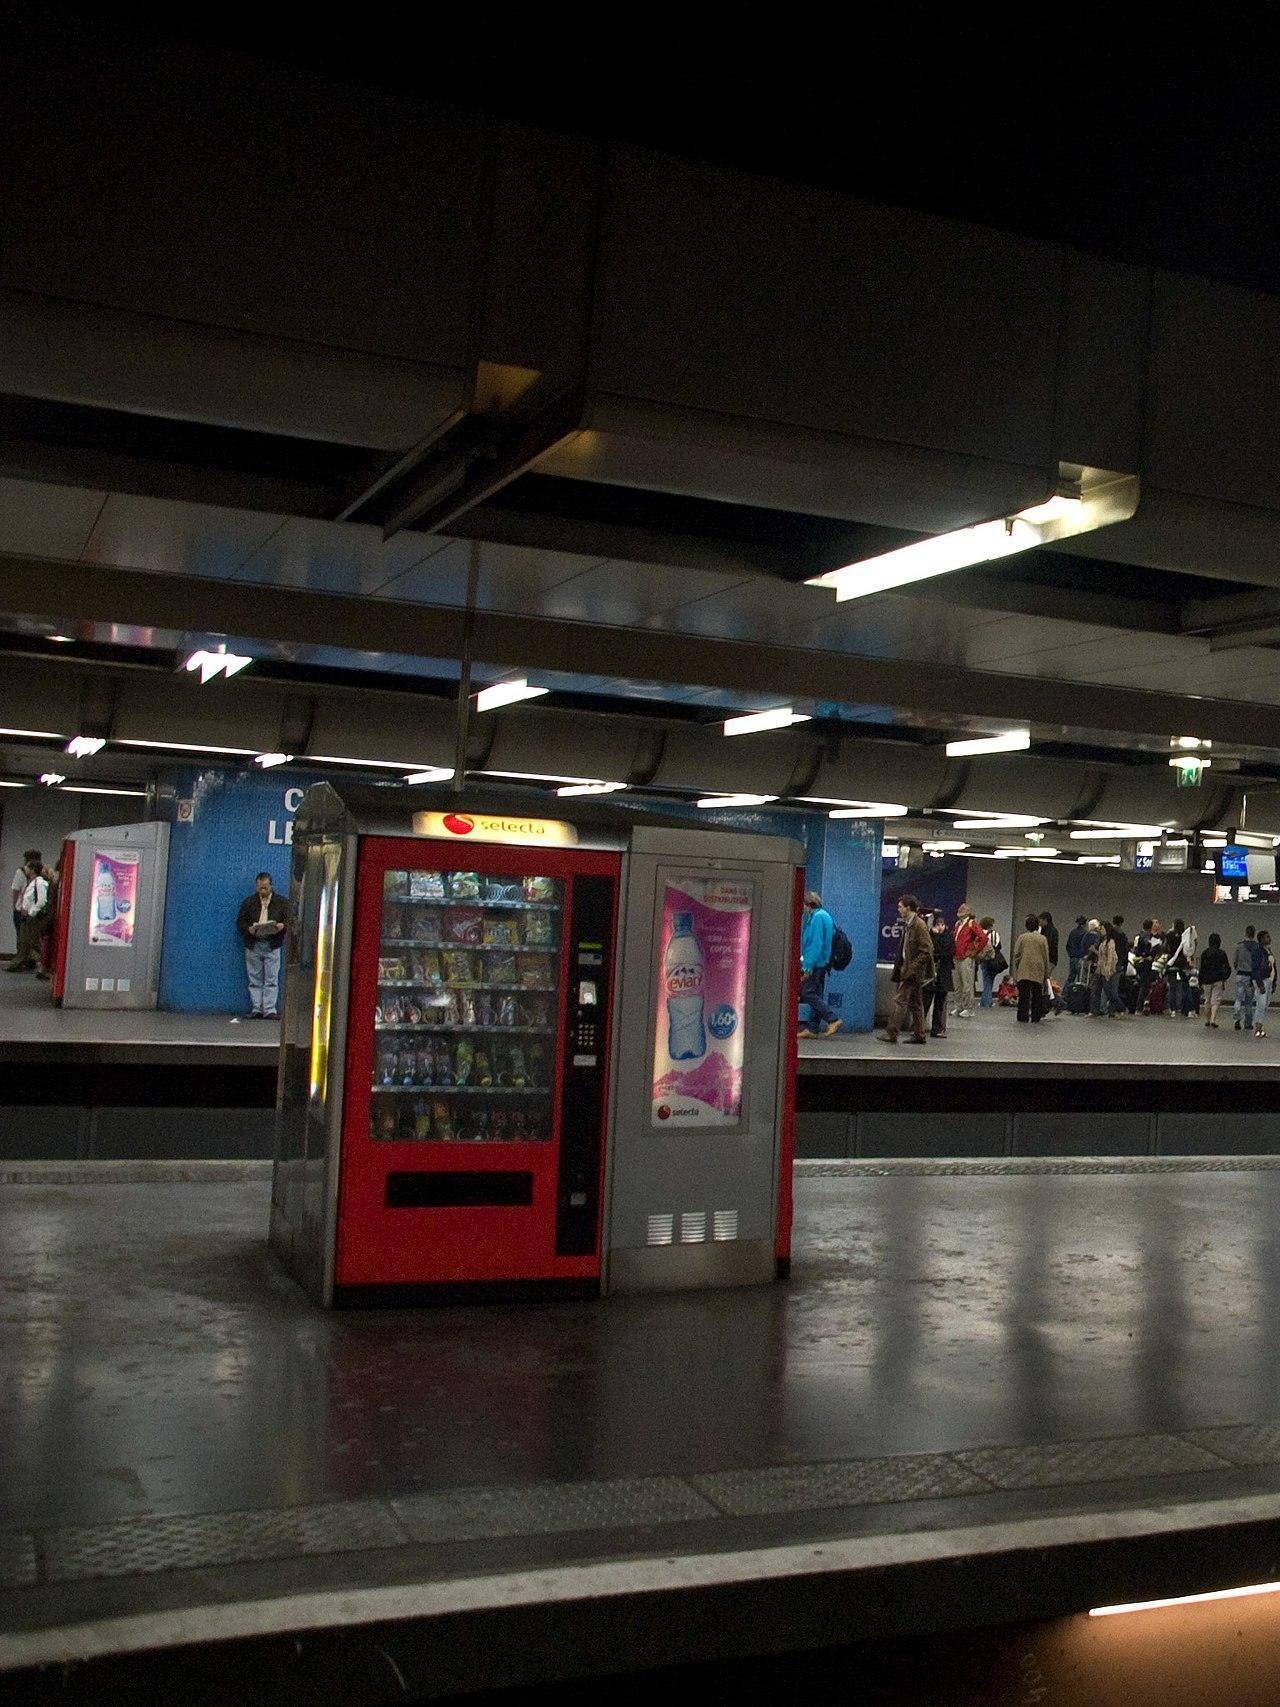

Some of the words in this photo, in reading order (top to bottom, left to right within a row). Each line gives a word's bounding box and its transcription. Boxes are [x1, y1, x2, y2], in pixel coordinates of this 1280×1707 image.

[480, 820, 545, 835] selecta
[670, 975, 702, 989] evian
[672, 1107, 699, 1116] selecta
